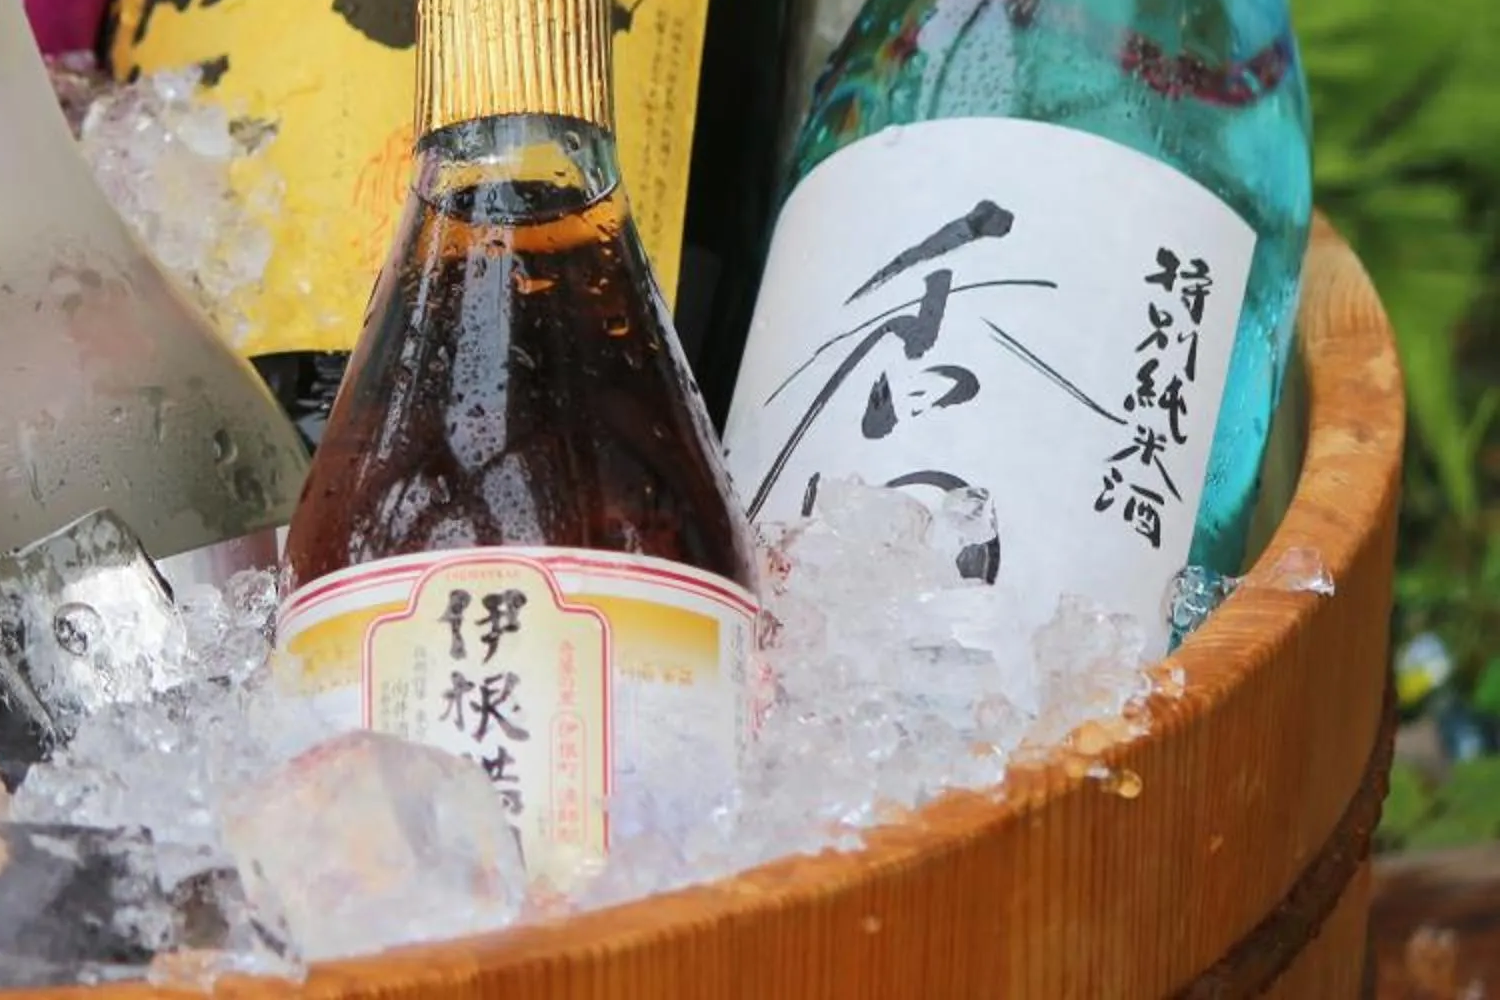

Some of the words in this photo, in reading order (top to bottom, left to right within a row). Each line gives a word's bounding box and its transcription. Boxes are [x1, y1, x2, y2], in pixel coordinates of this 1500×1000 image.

[1093, 245, 1216, 550] 特別純米酒
[437, 588, 533, 870] 伊根満
